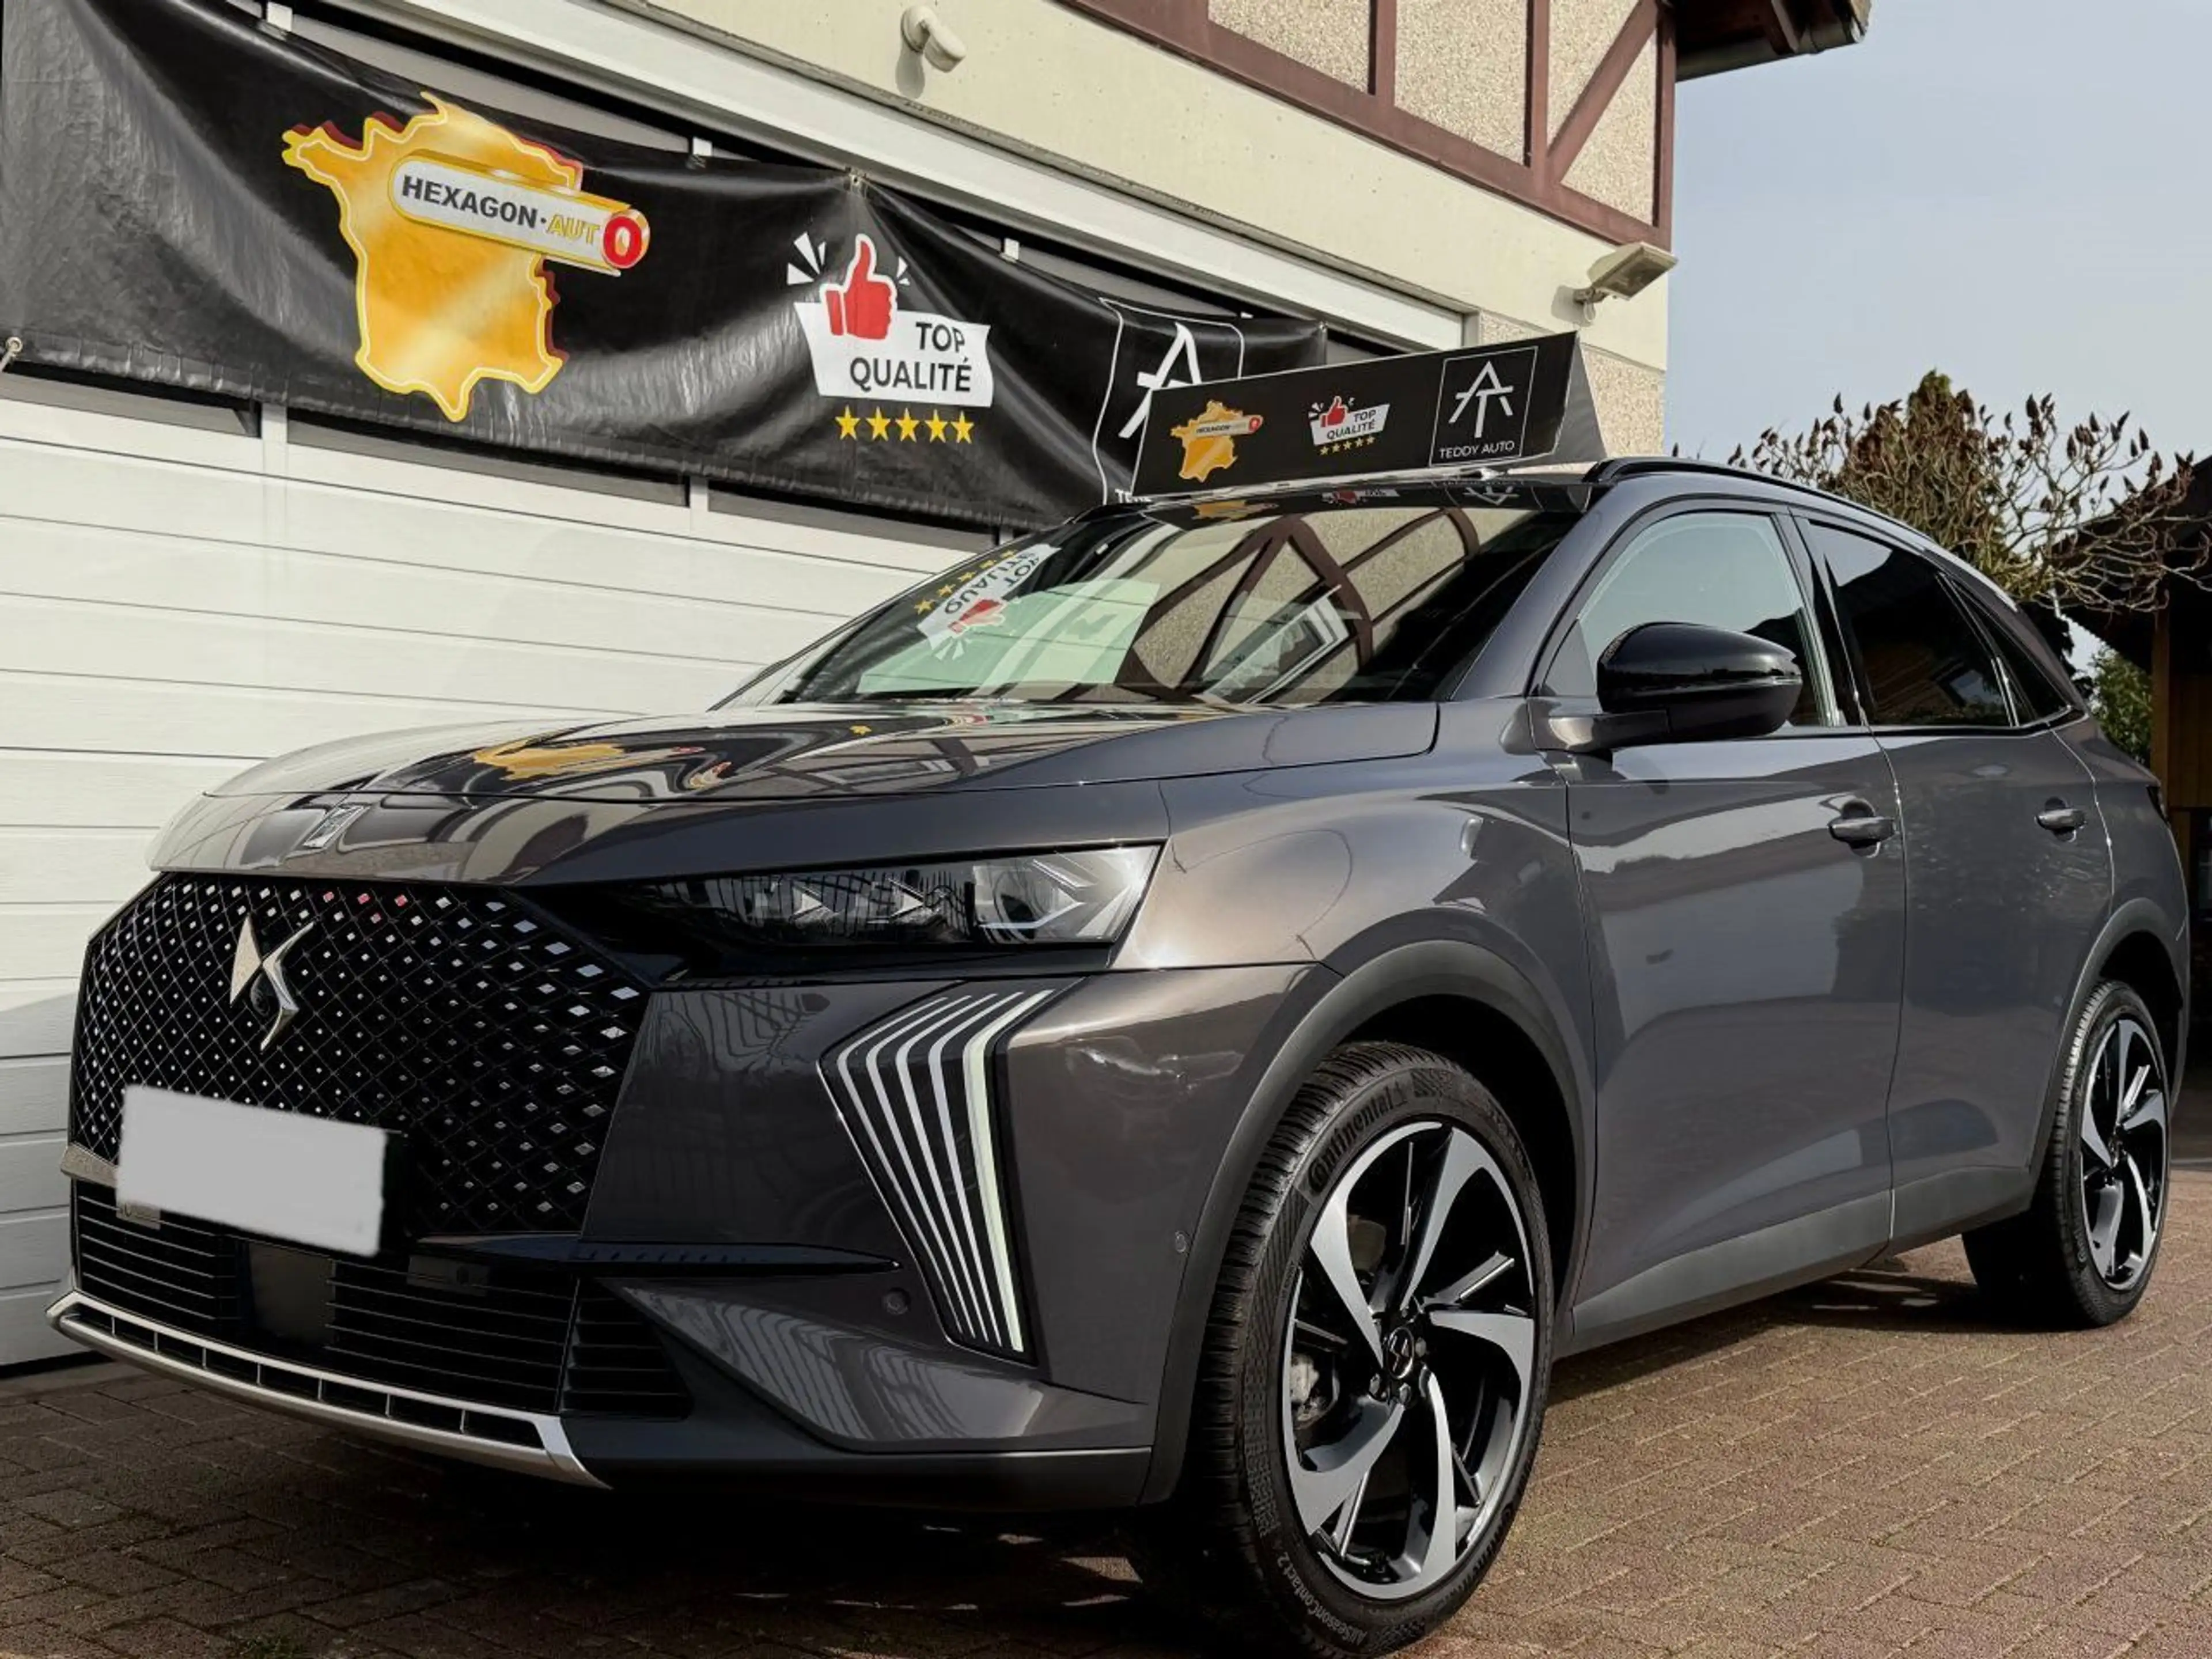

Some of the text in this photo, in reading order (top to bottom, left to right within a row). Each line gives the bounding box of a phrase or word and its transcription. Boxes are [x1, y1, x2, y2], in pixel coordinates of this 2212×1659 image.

[915, 321, 965, 353] TOP
[850, 355, 972, 392] QUALITÉ
[1354, 410, 1377, 423] TOP
[1327, 418, 1375, 440] QUALITÉ
[1439, 440, 1515, 459] TEDDY AUTO
